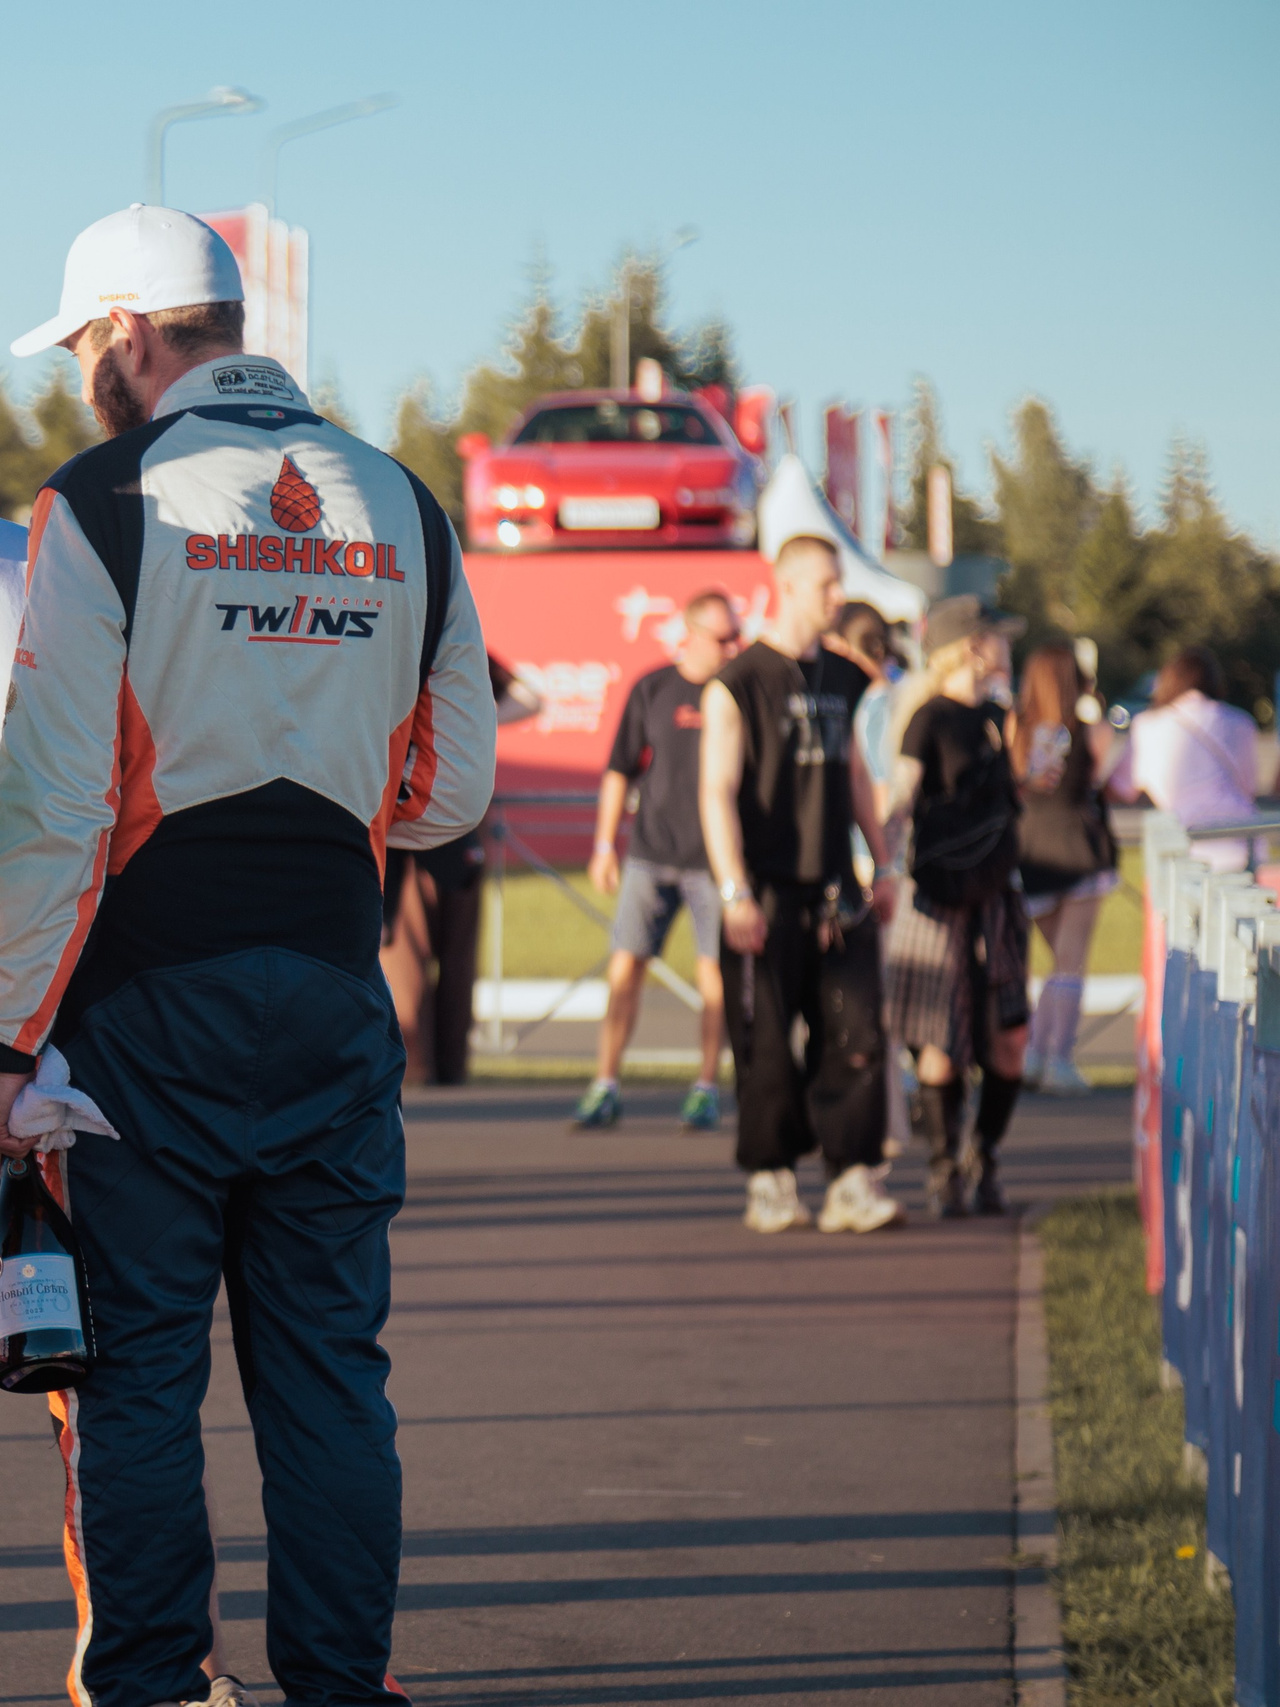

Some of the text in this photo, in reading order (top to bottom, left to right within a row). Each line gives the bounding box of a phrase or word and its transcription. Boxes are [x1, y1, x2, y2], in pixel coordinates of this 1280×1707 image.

[185, 534, 405, 583] SHISHKOIL
[215, 595, 379, 638] TWINS
[315, 596, 384, 609] RACING
